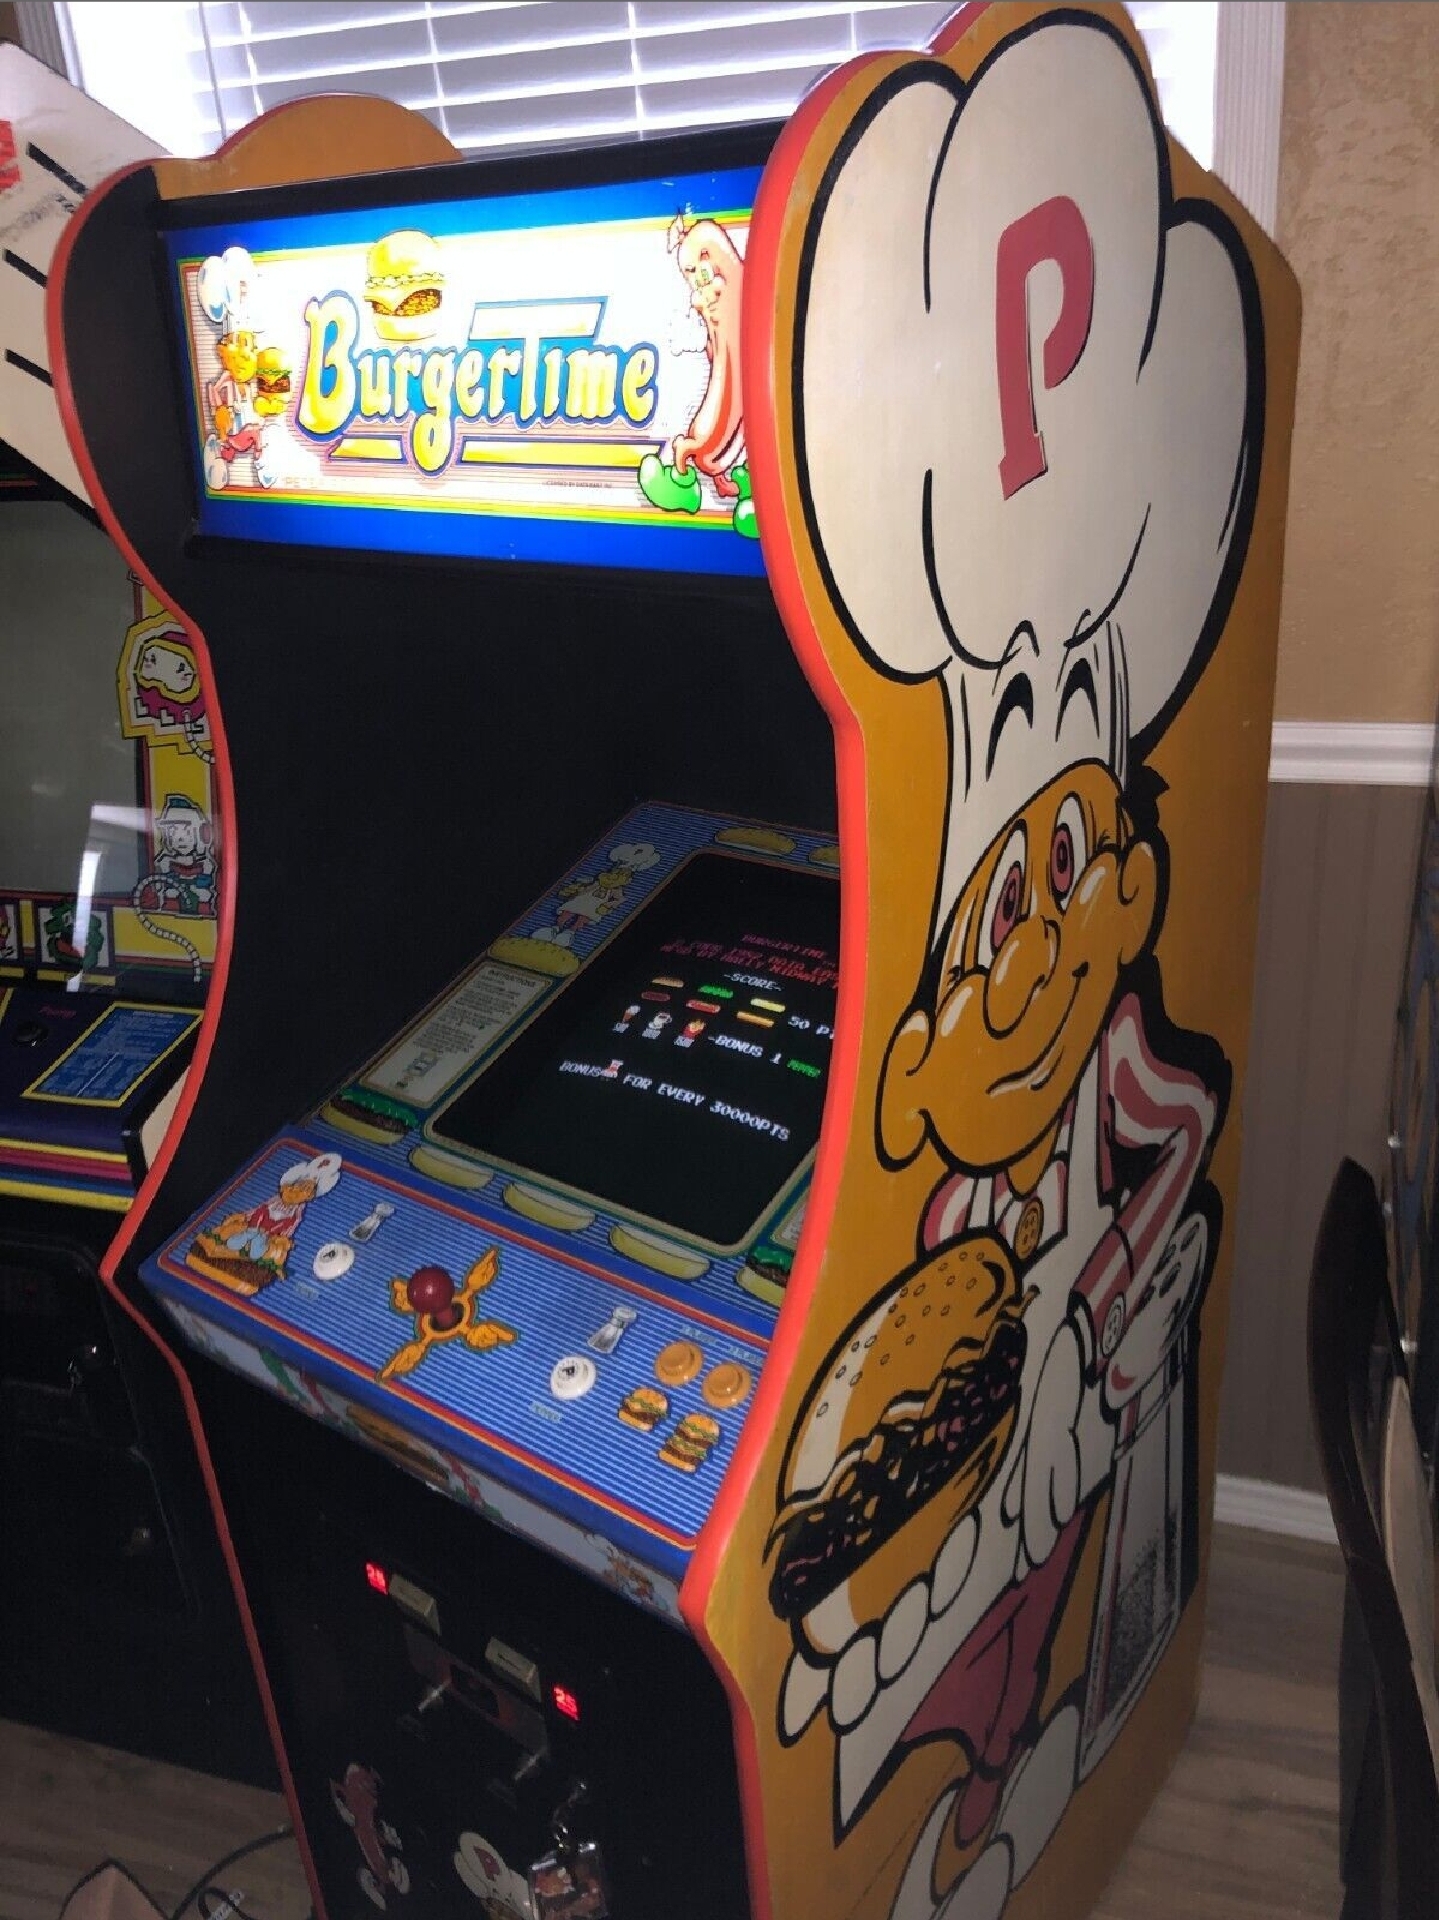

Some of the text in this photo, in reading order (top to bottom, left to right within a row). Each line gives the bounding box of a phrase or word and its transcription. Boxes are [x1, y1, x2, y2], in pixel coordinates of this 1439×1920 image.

[995, 195, 1095, 501] P
[623, 1075, 652, 1090] FOR
[657, 1083, 706, 1106] EVERY
